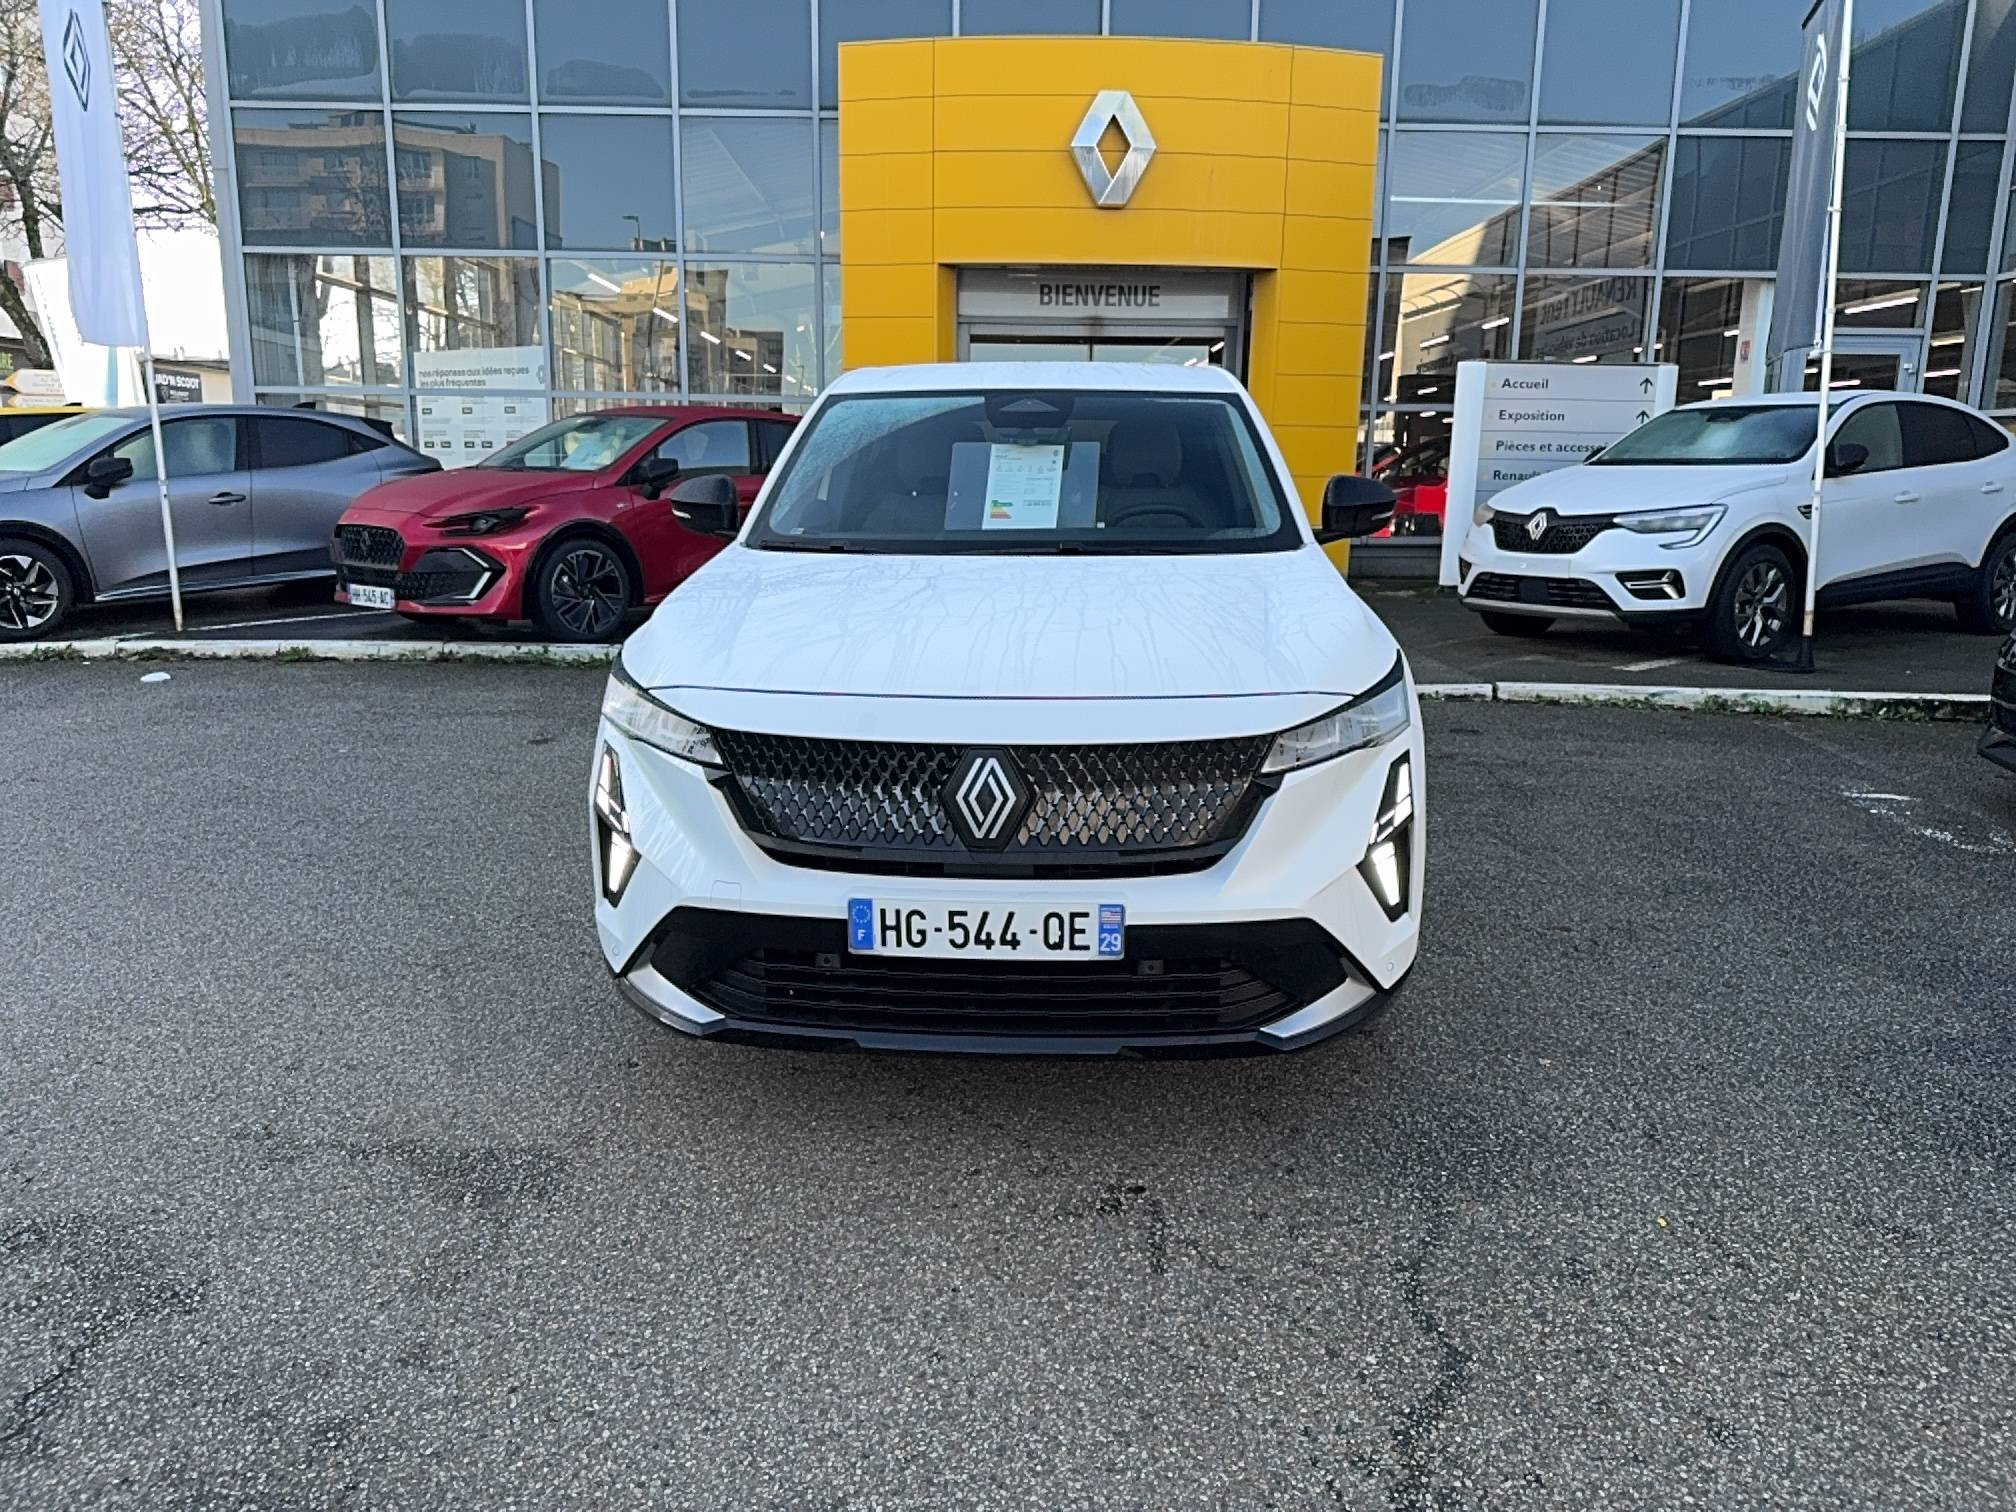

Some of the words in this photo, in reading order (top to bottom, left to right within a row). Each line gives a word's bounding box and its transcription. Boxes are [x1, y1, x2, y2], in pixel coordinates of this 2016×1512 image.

[1039, 284, 1161, 307] BIENVENUE
[1501, 377, 1549, 390] Accueil
[1498, 409, 1565, 423] Exposition
[1496, 440, 1535, 452] Pièces
[1539, 441, 1553, 453] et
[1556, 441, 1608, 453] access
[857, 929, 866, 941] F
[879, 908, 1091, 951] HG-544-QE
[1100, 932, 1122, 952] 29
